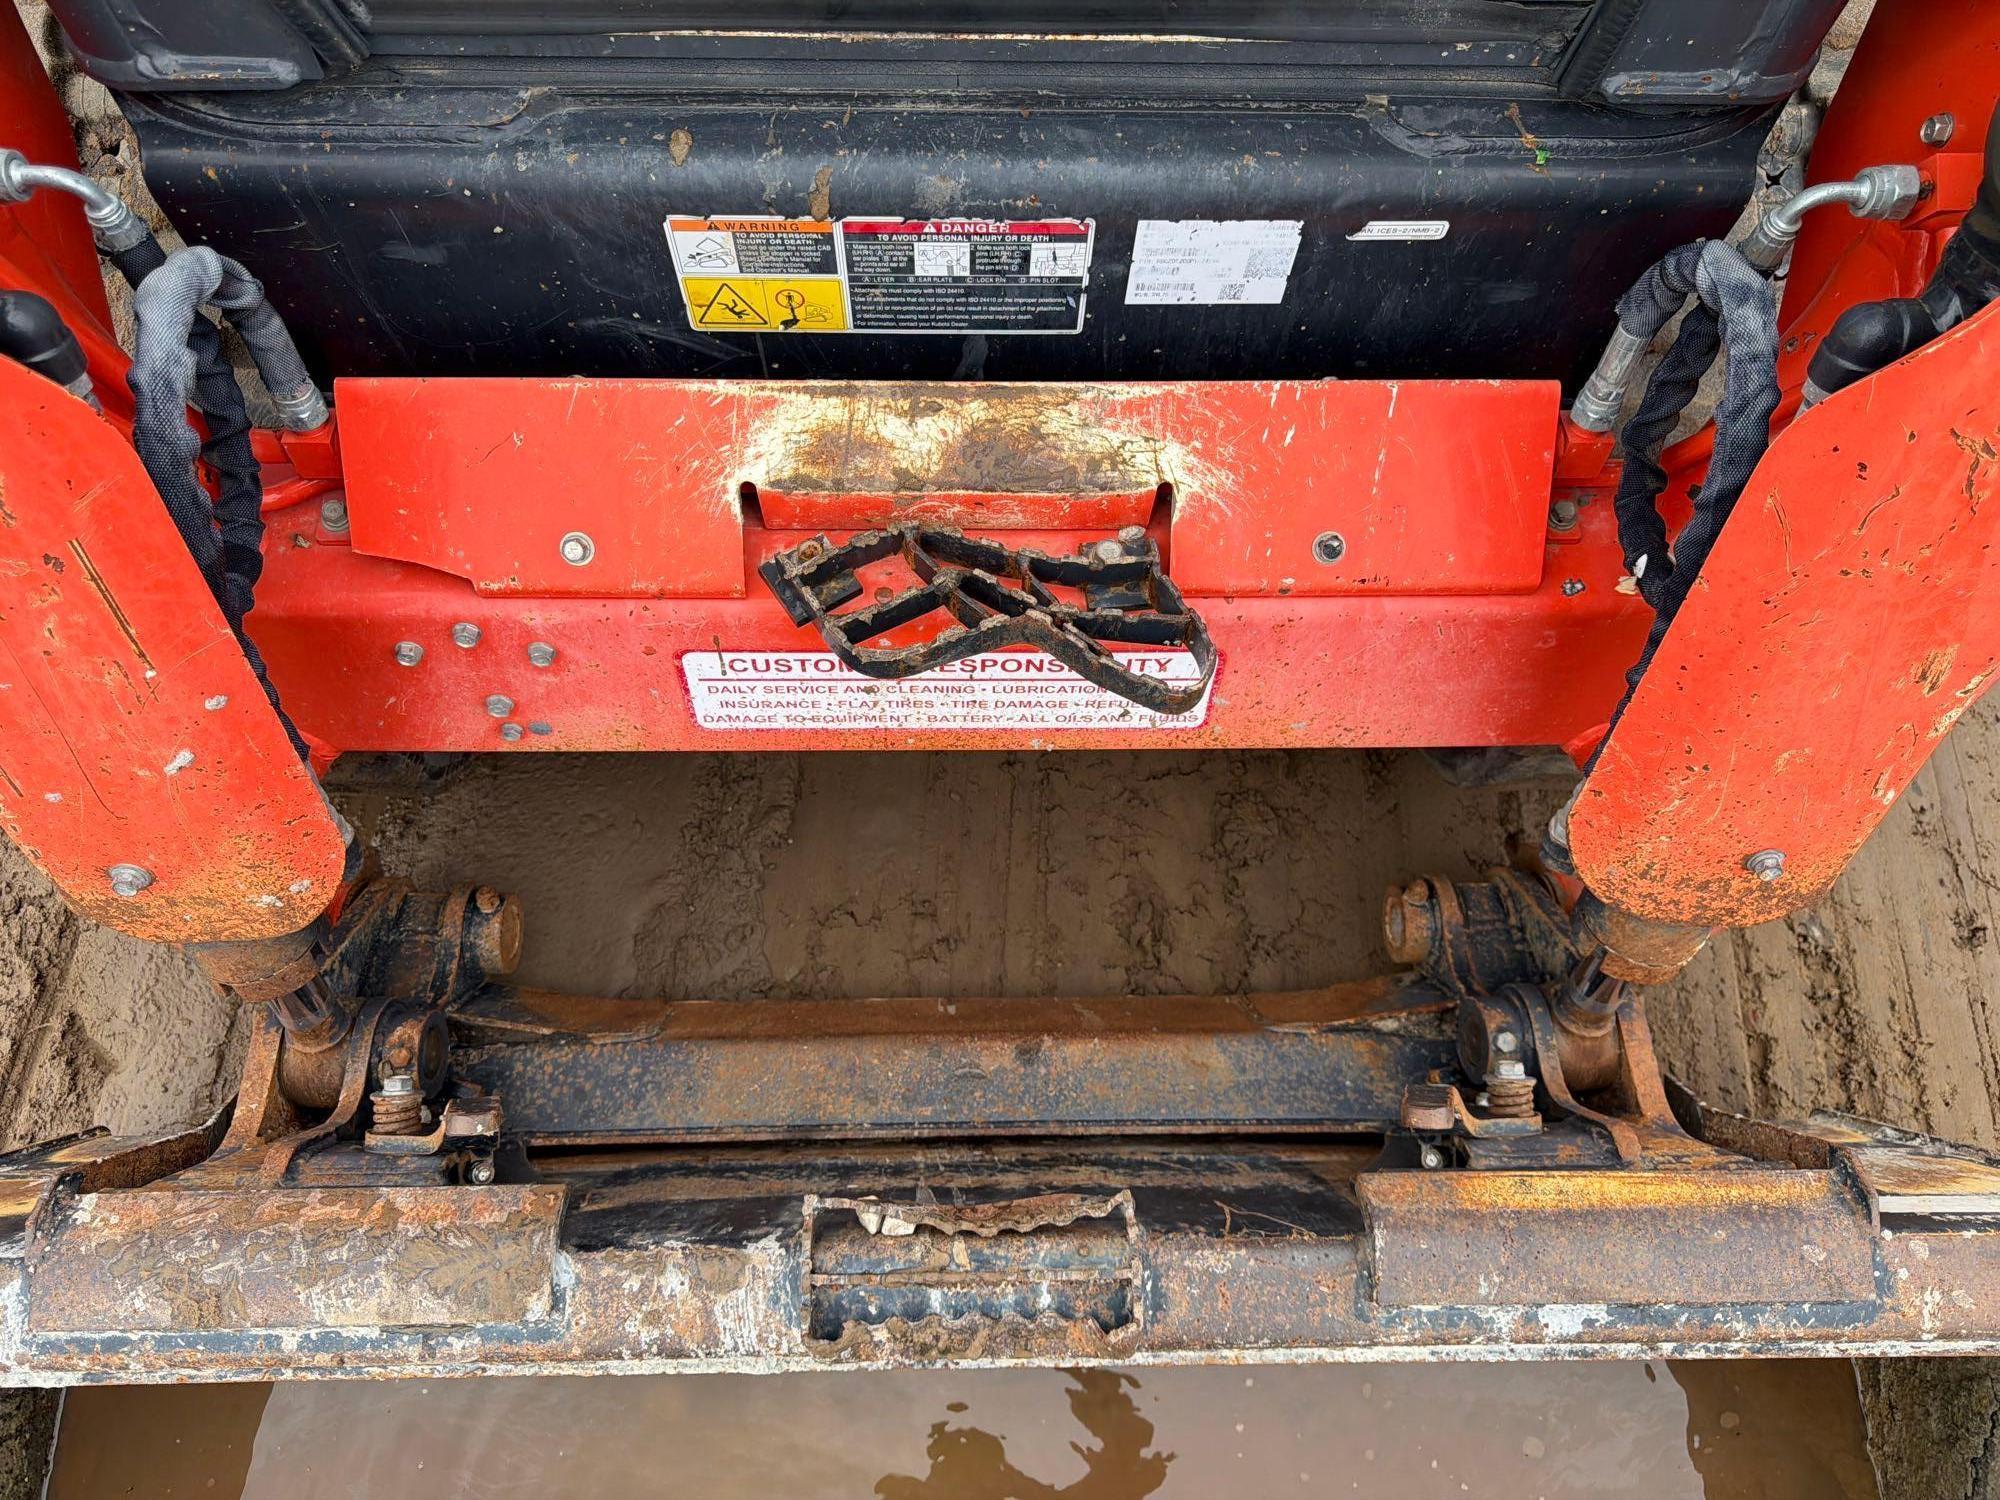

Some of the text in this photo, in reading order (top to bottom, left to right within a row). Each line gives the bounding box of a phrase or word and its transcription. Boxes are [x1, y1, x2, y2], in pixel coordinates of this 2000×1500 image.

[724, 222, 800, 231] WARNING
[942, 223, 1010, 233] DANGER
[707, 685, 758, 694] DAILY
[763, 685, 838, 694] SERVICE
[843, 685, 880, 694] AND
[886, 685, 976, 694] CLEANING
[719, 700, 821, 709] INSURANCE
[838, 700, 880, 709] FLAT
[887, 700, 935, 709] TIRES
[951, 700, 989, 709] TIRE
[995, 700, 1068, 709] DAMAGE
[703, 714, 1199, 723] DAMAGE TO EQUIPMENT BATTERY ALL OILS AND FLUIDS
